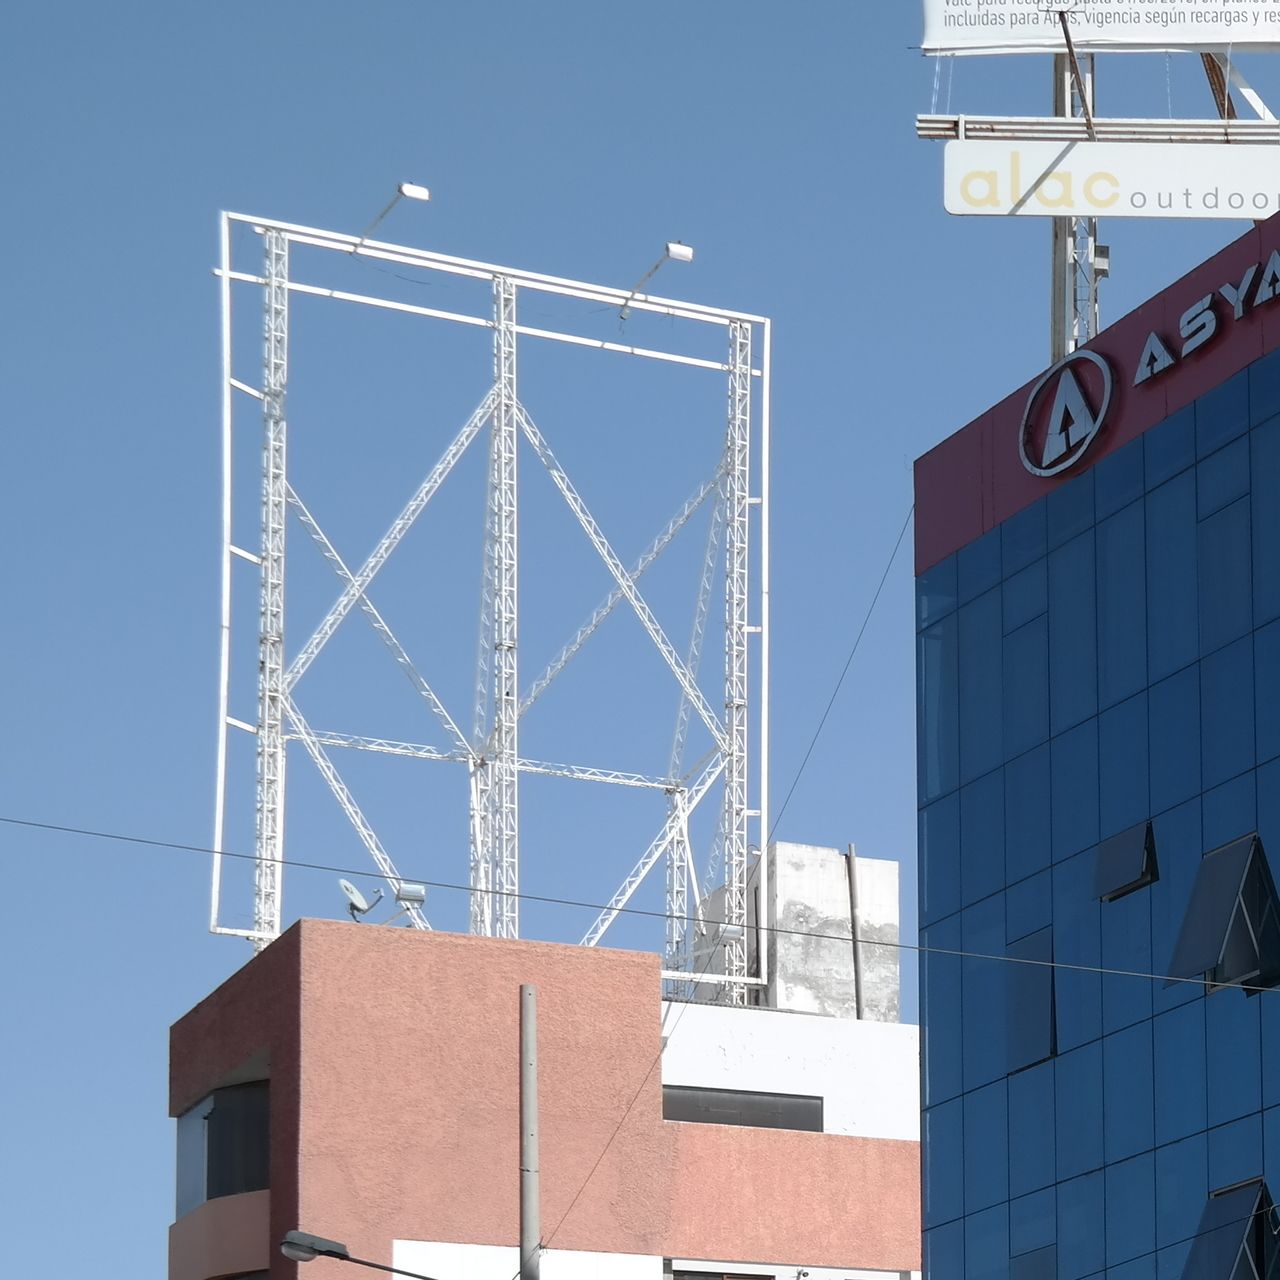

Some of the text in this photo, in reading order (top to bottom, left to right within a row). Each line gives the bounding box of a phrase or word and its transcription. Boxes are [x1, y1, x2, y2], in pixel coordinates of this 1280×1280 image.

[944, 10, 1006, 27] incluidas
[1010, 13, 1039, 29] para
[1085, 8, 1141, 28] vigencia
[1145, 7, 1186, 28] según
[1191, 11, 1248, 27] recargas
[1253, 11, 1260, 26] y
[959, 150, 1121, 209] alac
